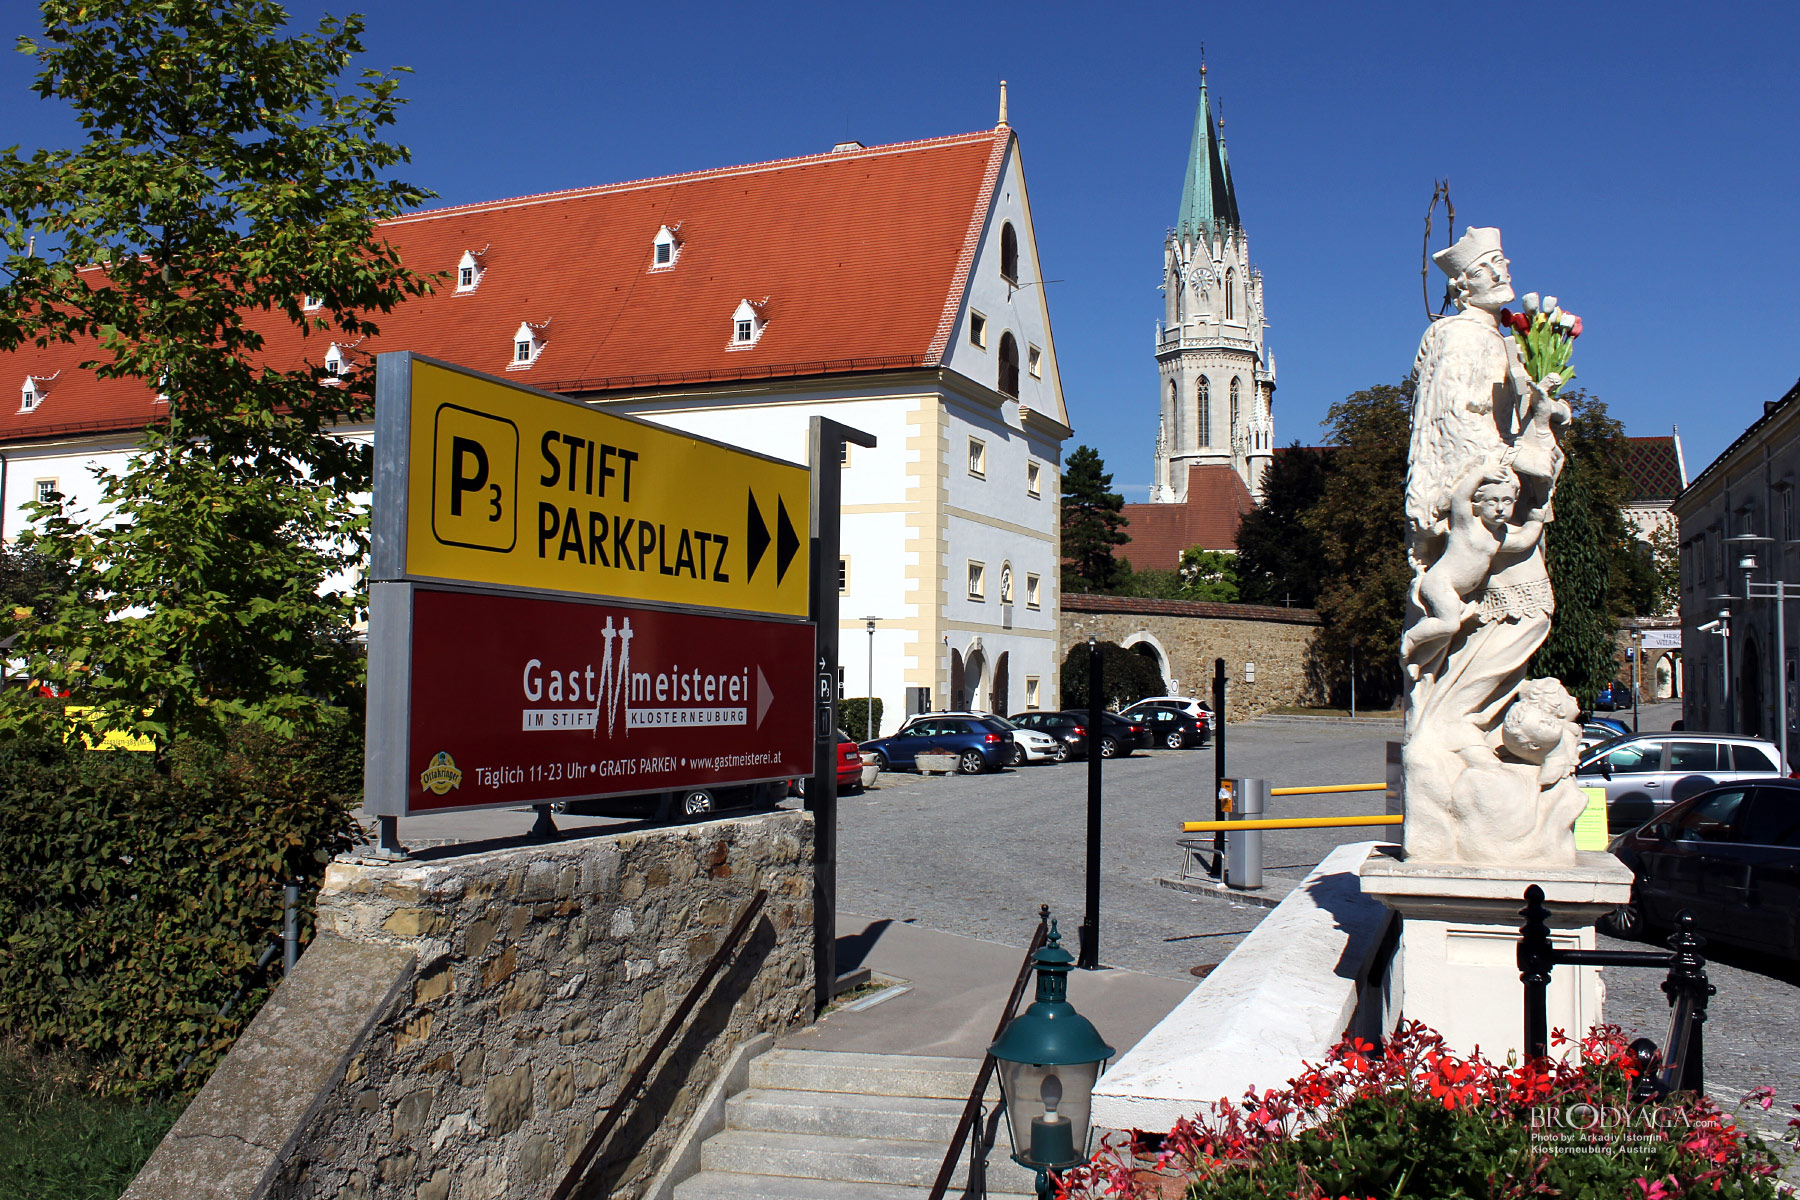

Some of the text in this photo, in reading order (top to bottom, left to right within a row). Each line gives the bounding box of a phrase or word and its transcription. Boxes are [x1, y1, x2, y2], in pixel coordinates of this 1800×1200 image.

[540, 430, 639, 503] STIFT
[538, 501, 730, 583] PARKPLATZ
[528, 711, 744, 727] IM STIFT KLOSTERNEUBURG
[475, 750, 782, 789] Täglich 11-23 Uhr GRATIS PARKEN www.gastmeisterei.at
